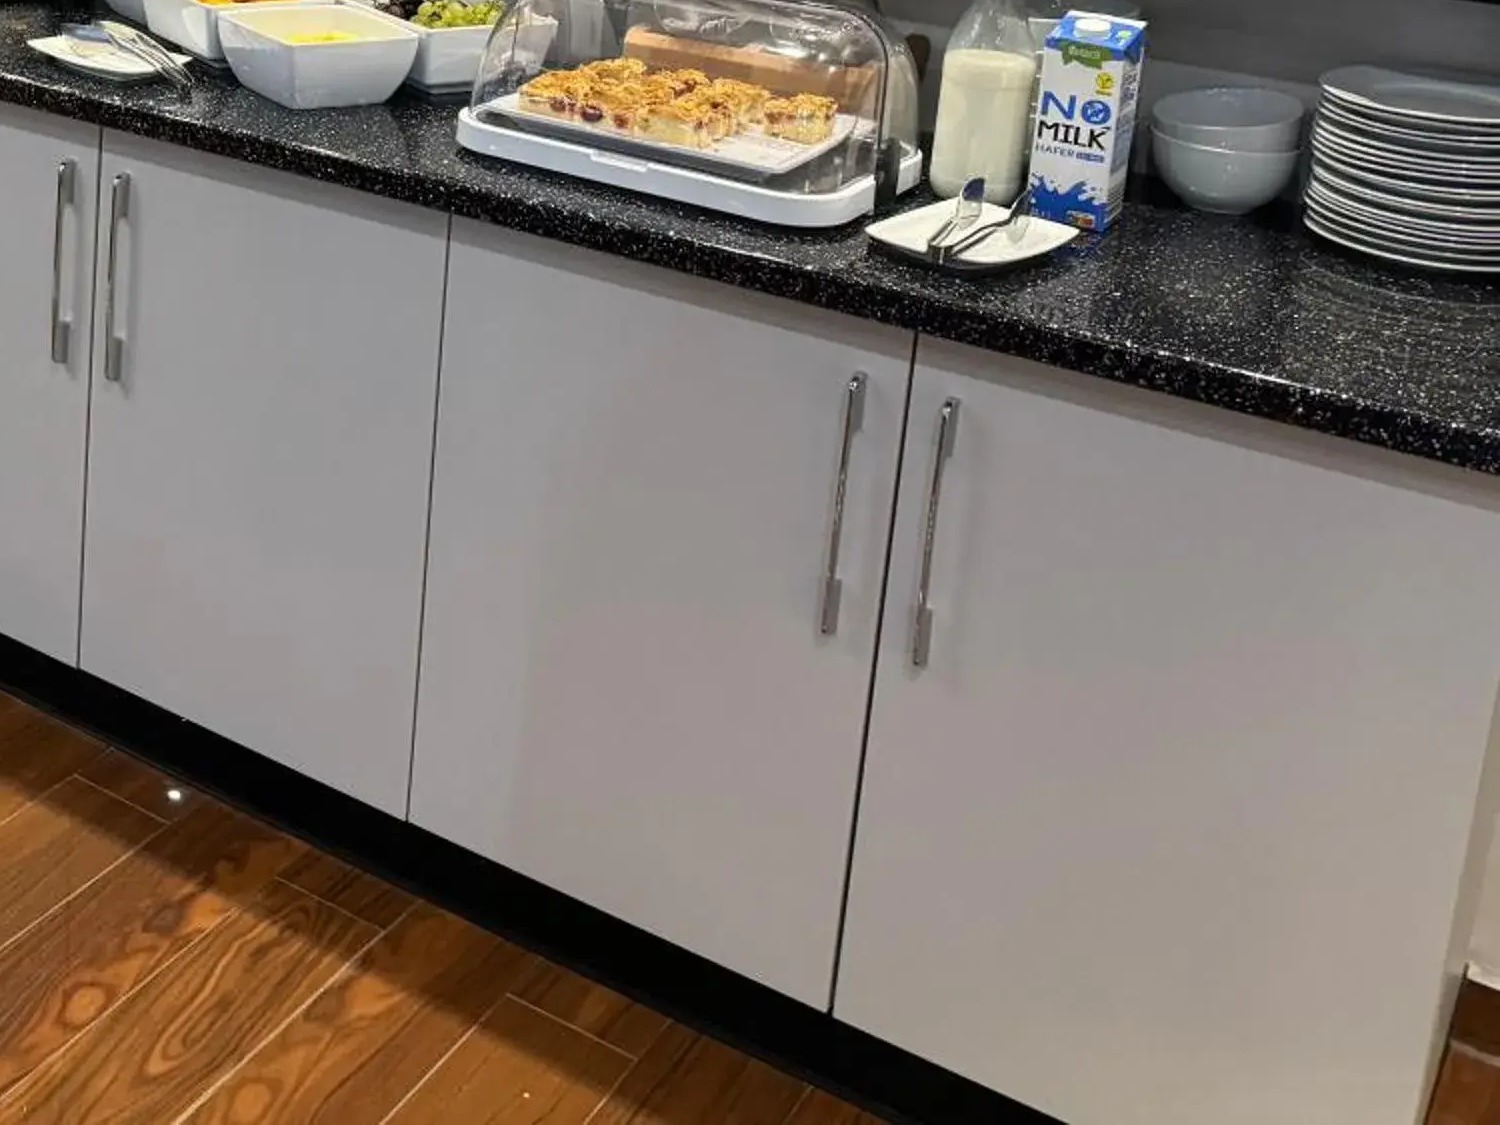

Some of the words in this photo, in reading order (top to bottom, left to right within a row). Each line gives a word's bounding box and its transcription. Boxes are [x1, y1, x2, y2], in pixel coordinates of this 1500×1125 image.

[1040, 90, 1111, 125] NO
[1035, 141, 1075, 157] HAFER
[1037, 119, 1111, 151] MILK
